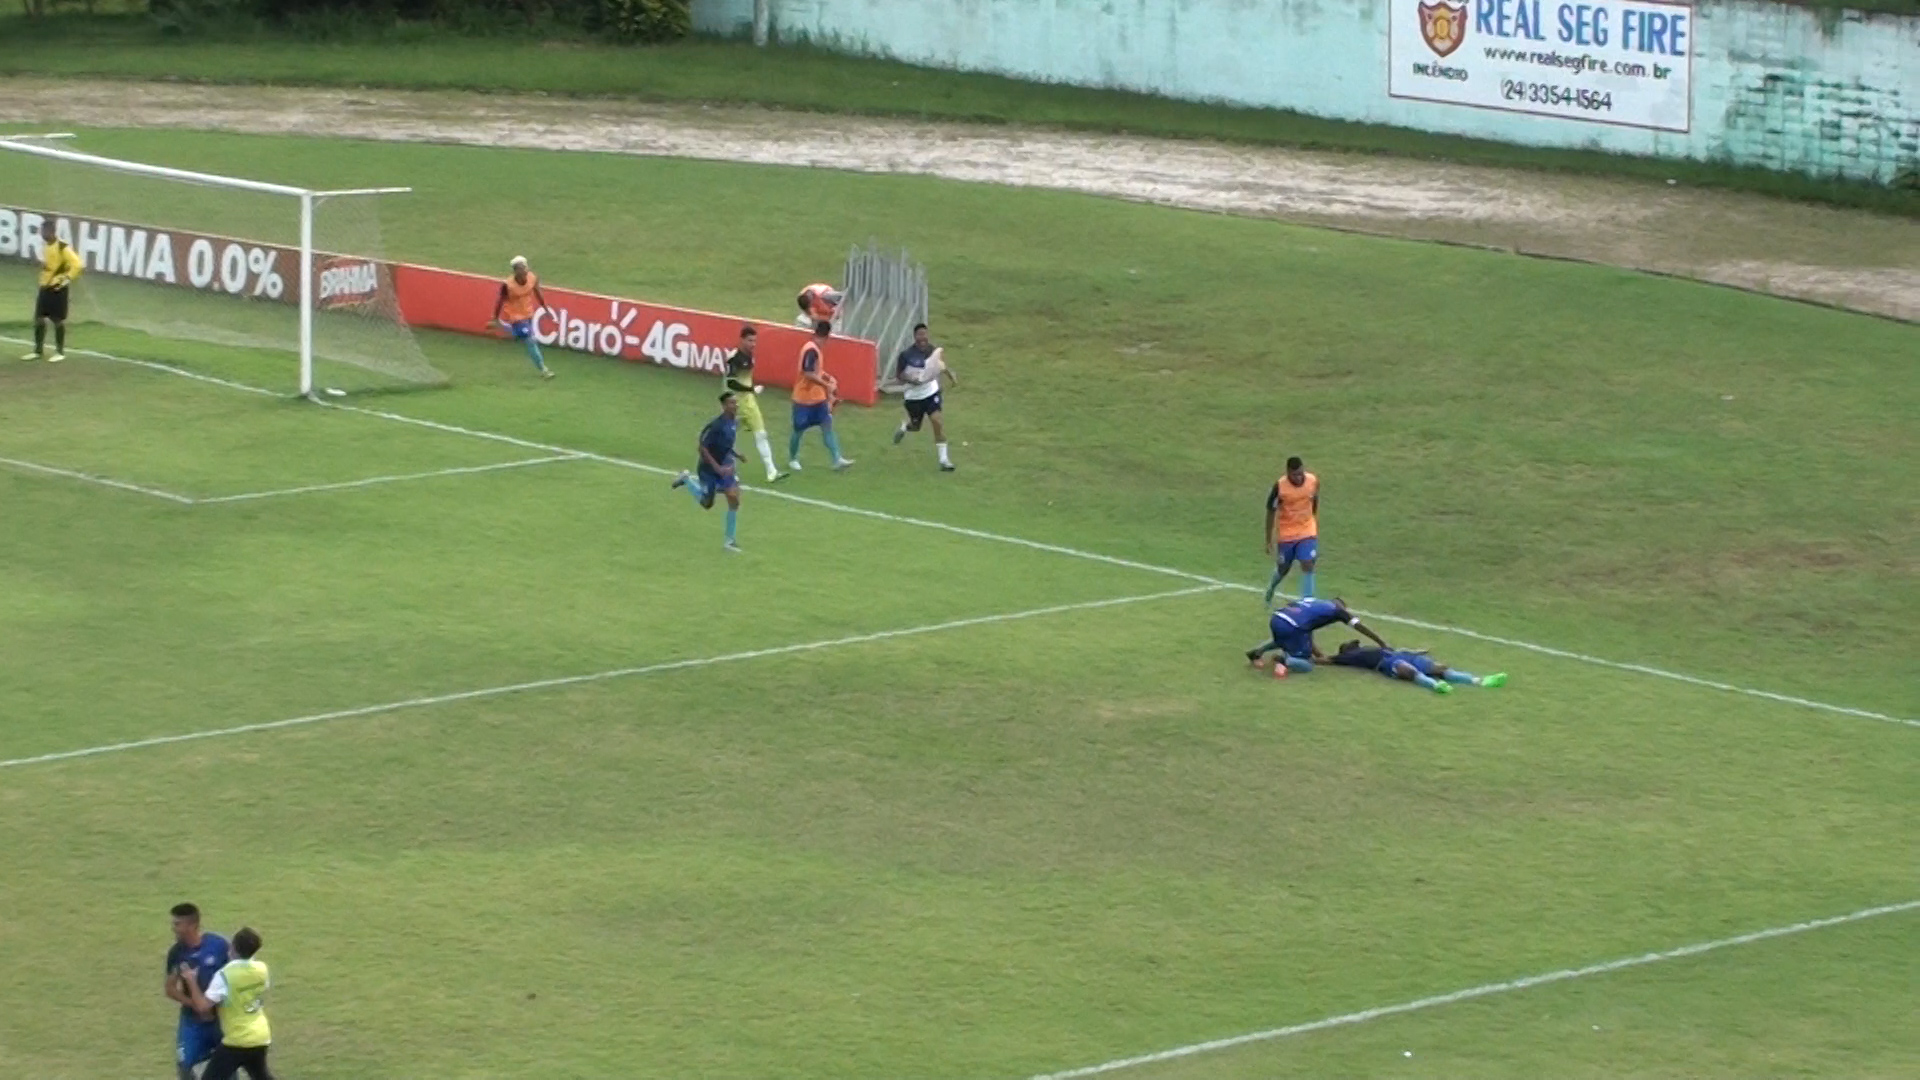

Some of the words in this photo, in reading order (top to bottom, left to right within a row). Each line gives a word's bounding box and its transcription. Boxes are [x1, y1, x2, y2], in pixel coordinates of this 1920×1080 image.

[1475, 0, 1547, 41] REAL
[1557, 3, 1609, 47] SEG
[1621, 9, 1687, 57] FIRE
[0, 208, 176, 283] BRAHMA
[189, 240, 283, 298] 0.0%
[533, 307, 622, 356] Claro
